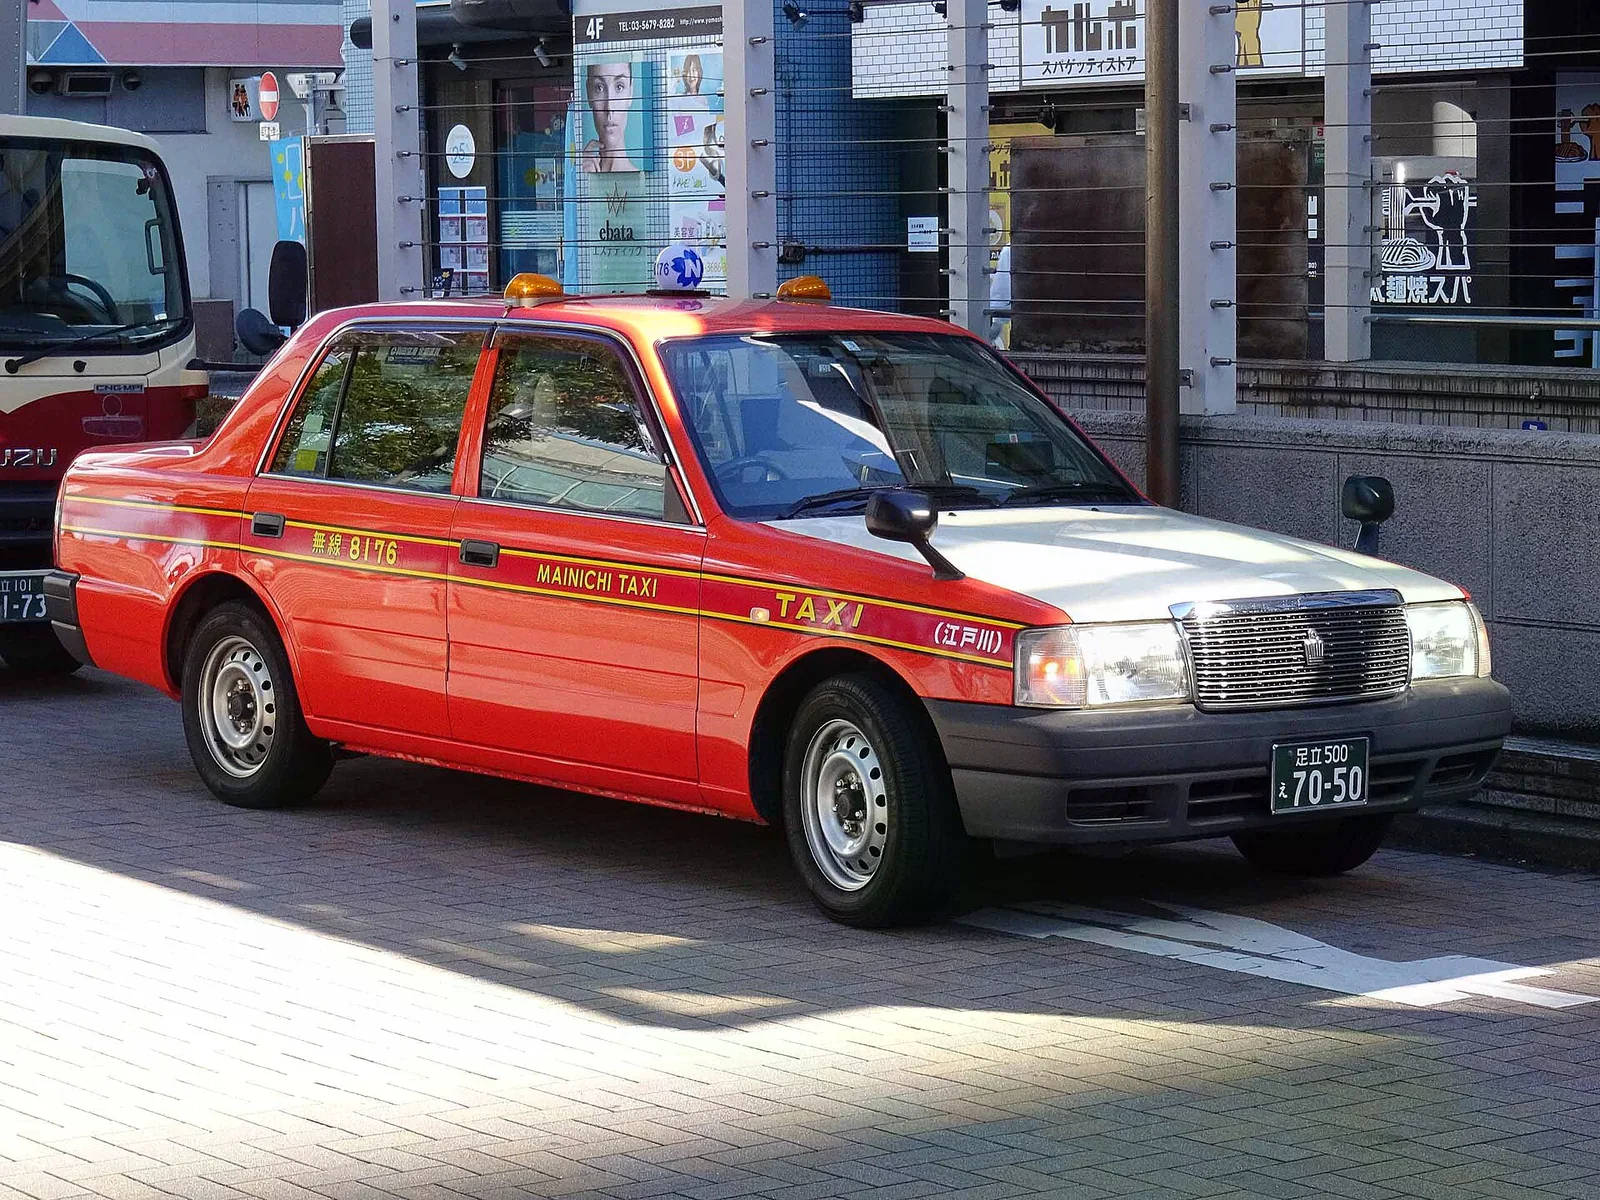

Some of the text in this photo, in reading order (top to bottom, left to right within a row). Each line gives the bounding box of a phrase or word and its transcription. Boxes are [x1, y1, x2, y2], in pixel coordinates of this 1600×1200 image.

[586, 18, 604, 40] 4F
[1041, 0, 1136, 53] カルボ
[1041, 56, 1137, 75] スパゲッティストア
[676, 150, 694, 169] 3F
[599, 220, 635, 240] ebata
[684, 258, 701, 278] N
[312, 531, 398, 565] 無線 8176
[536, 563, 658, 598] MAINICHI TAXI
[776, 592, 864, 628] TAXI
[934, 622, 1002, 654] (江戸川)
[1278, 766, 1362, 807] え 70-50
